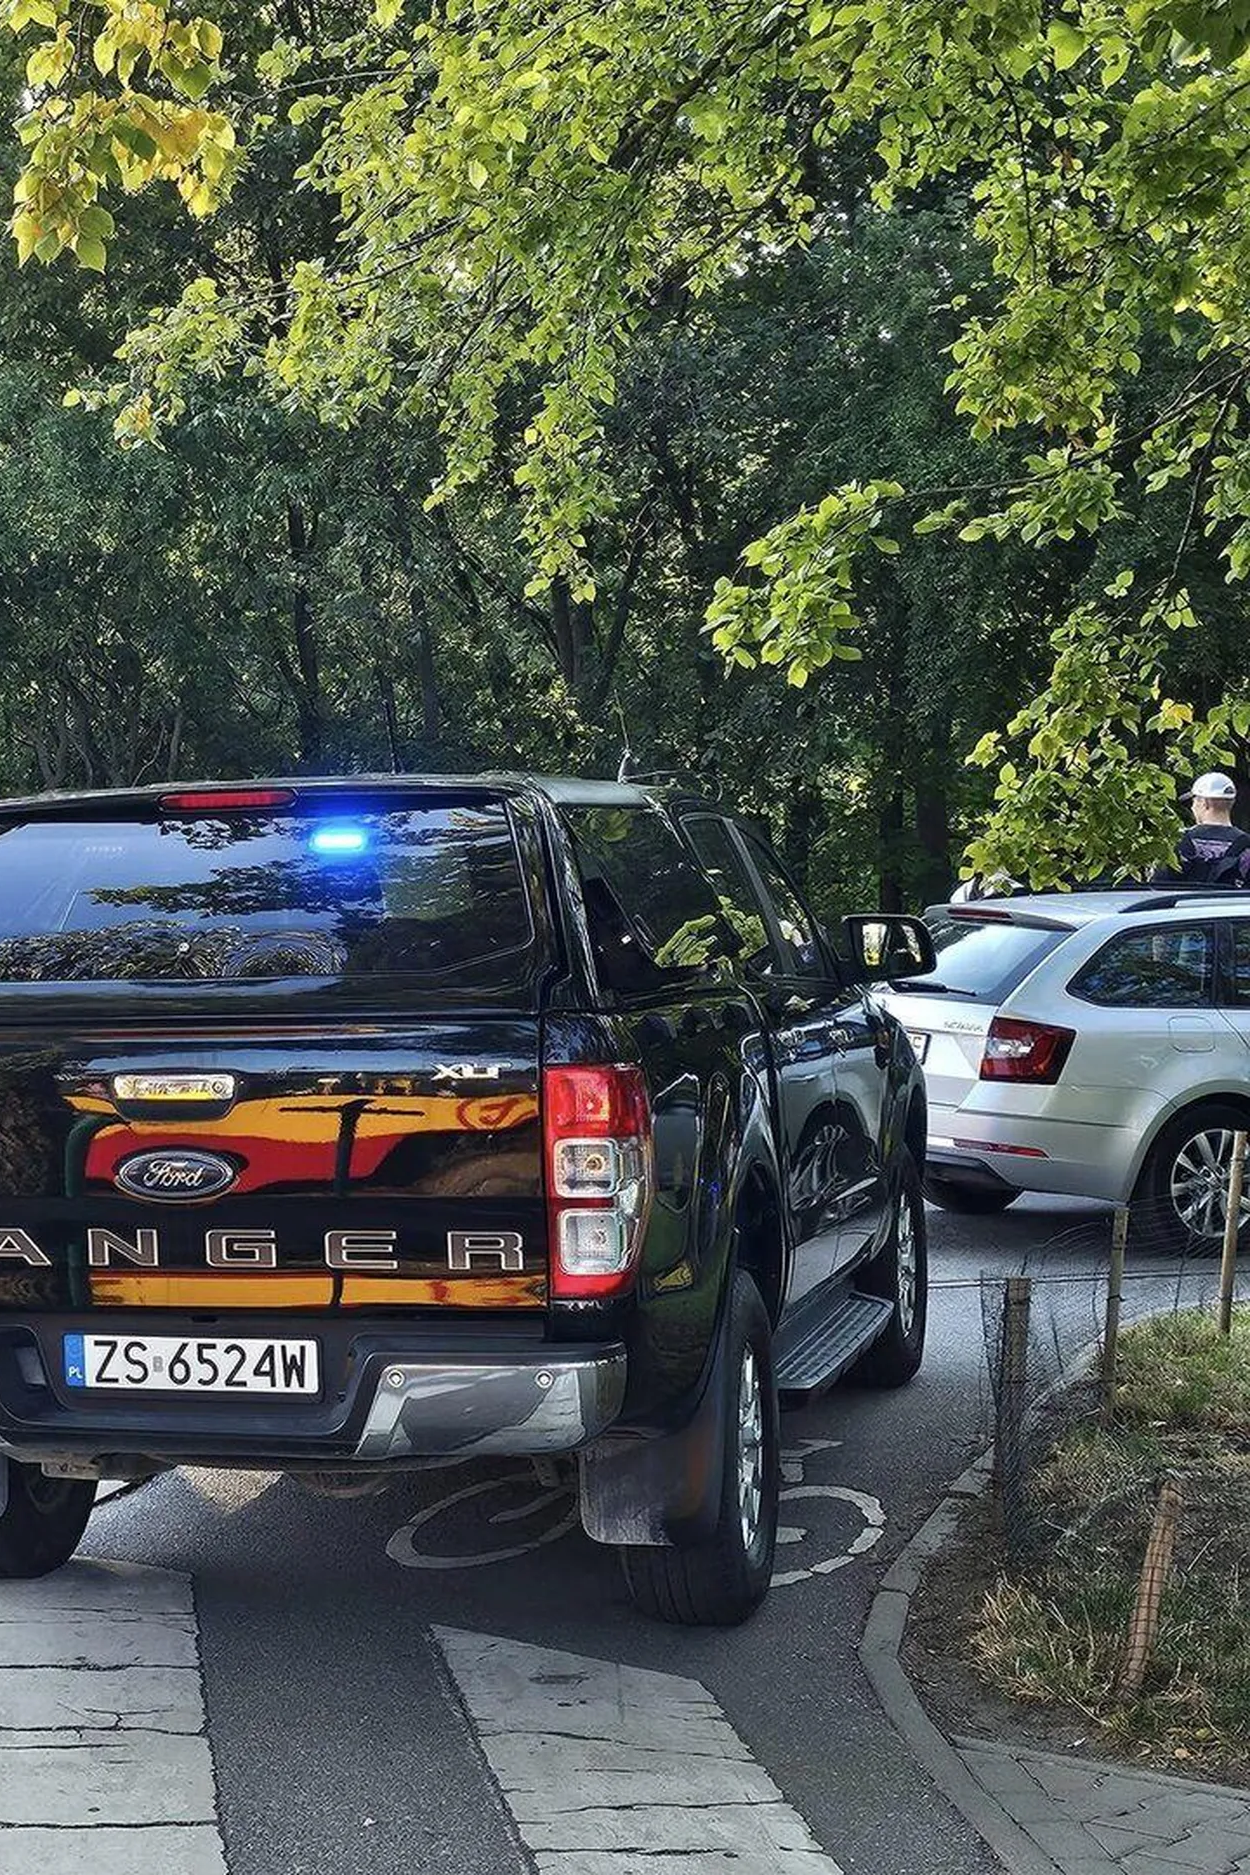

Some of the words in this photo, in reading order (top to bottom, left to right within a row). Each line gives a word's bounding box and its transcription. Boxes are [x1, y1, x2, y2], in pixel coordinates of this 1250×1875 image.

[430, 1062, 512, 1081] XLT
[143, 1160, 207, 1187] Ford
[68, 1366, 83, 1380] PL
